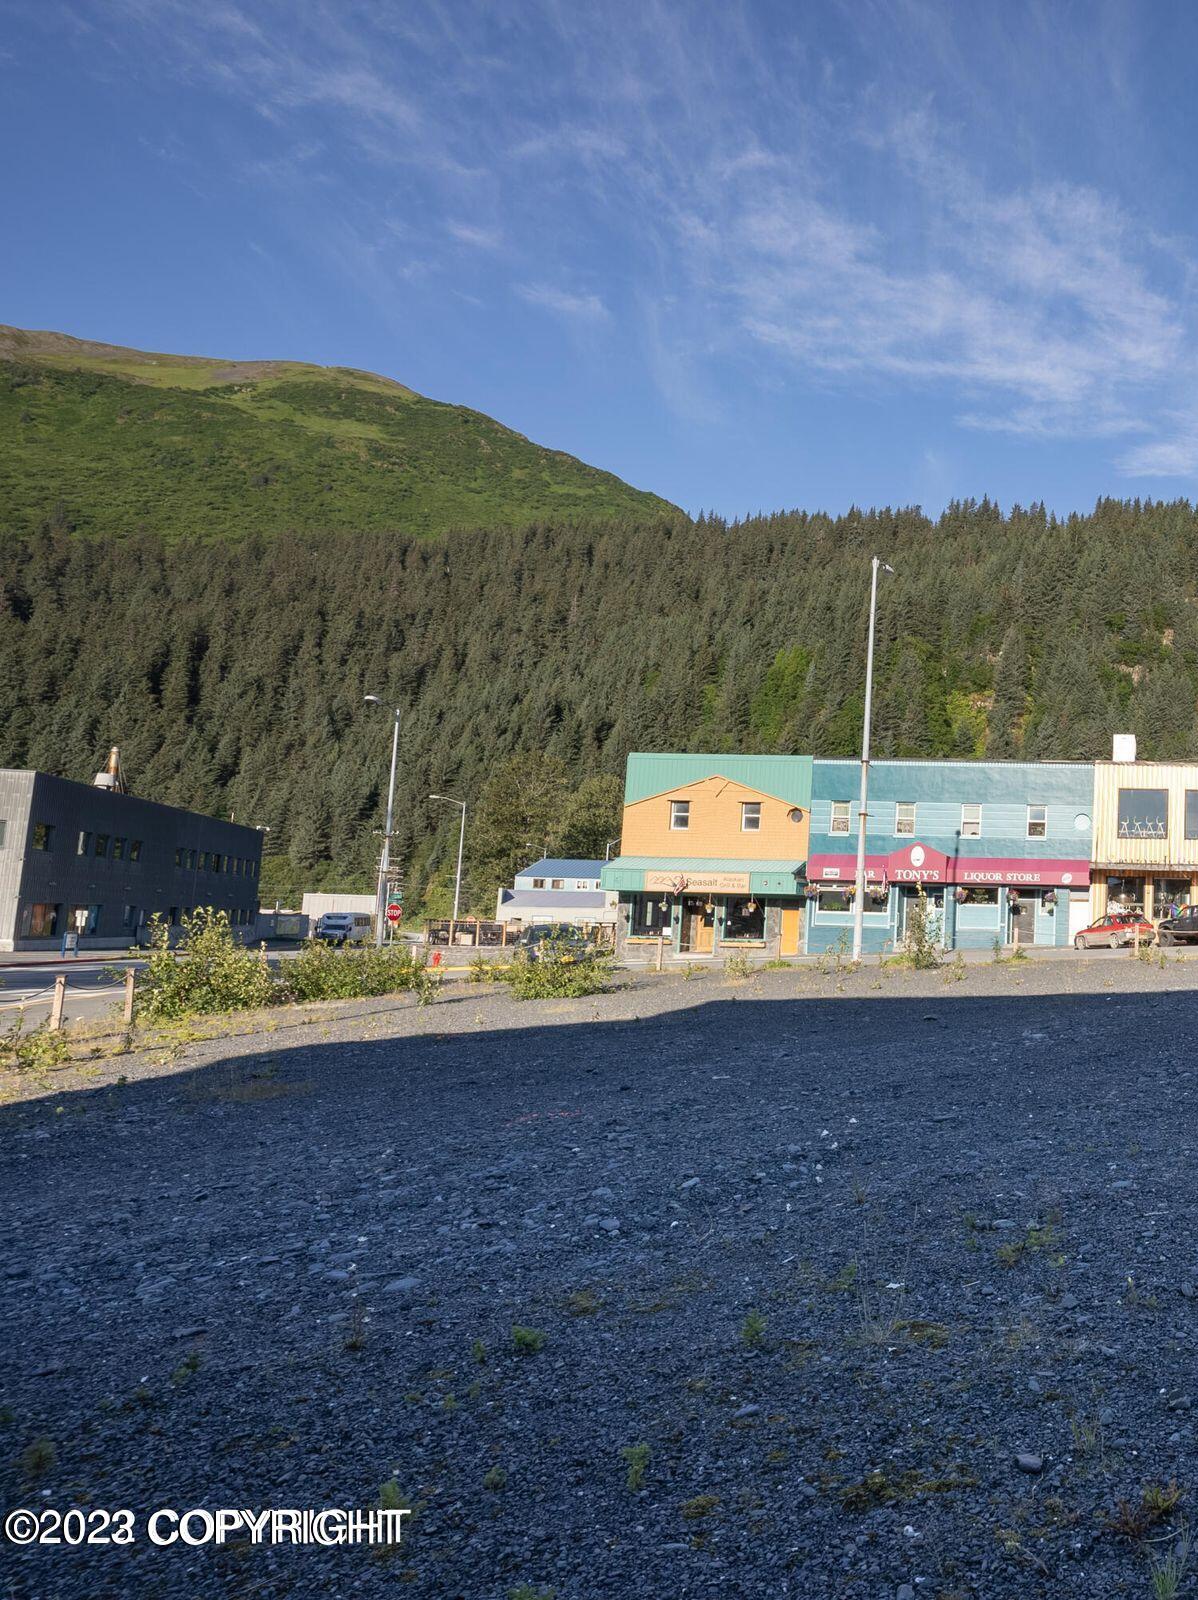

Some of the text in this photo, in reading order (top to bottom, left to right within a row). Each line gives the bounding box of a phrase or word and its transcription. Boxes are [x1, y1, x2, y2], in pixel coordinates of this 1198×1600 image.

[895, 869, 939, 880] TONY'S
[963, 872, 1041, 882] LIQUOR STORE
[686, 877, 718, 886] Seasalt
